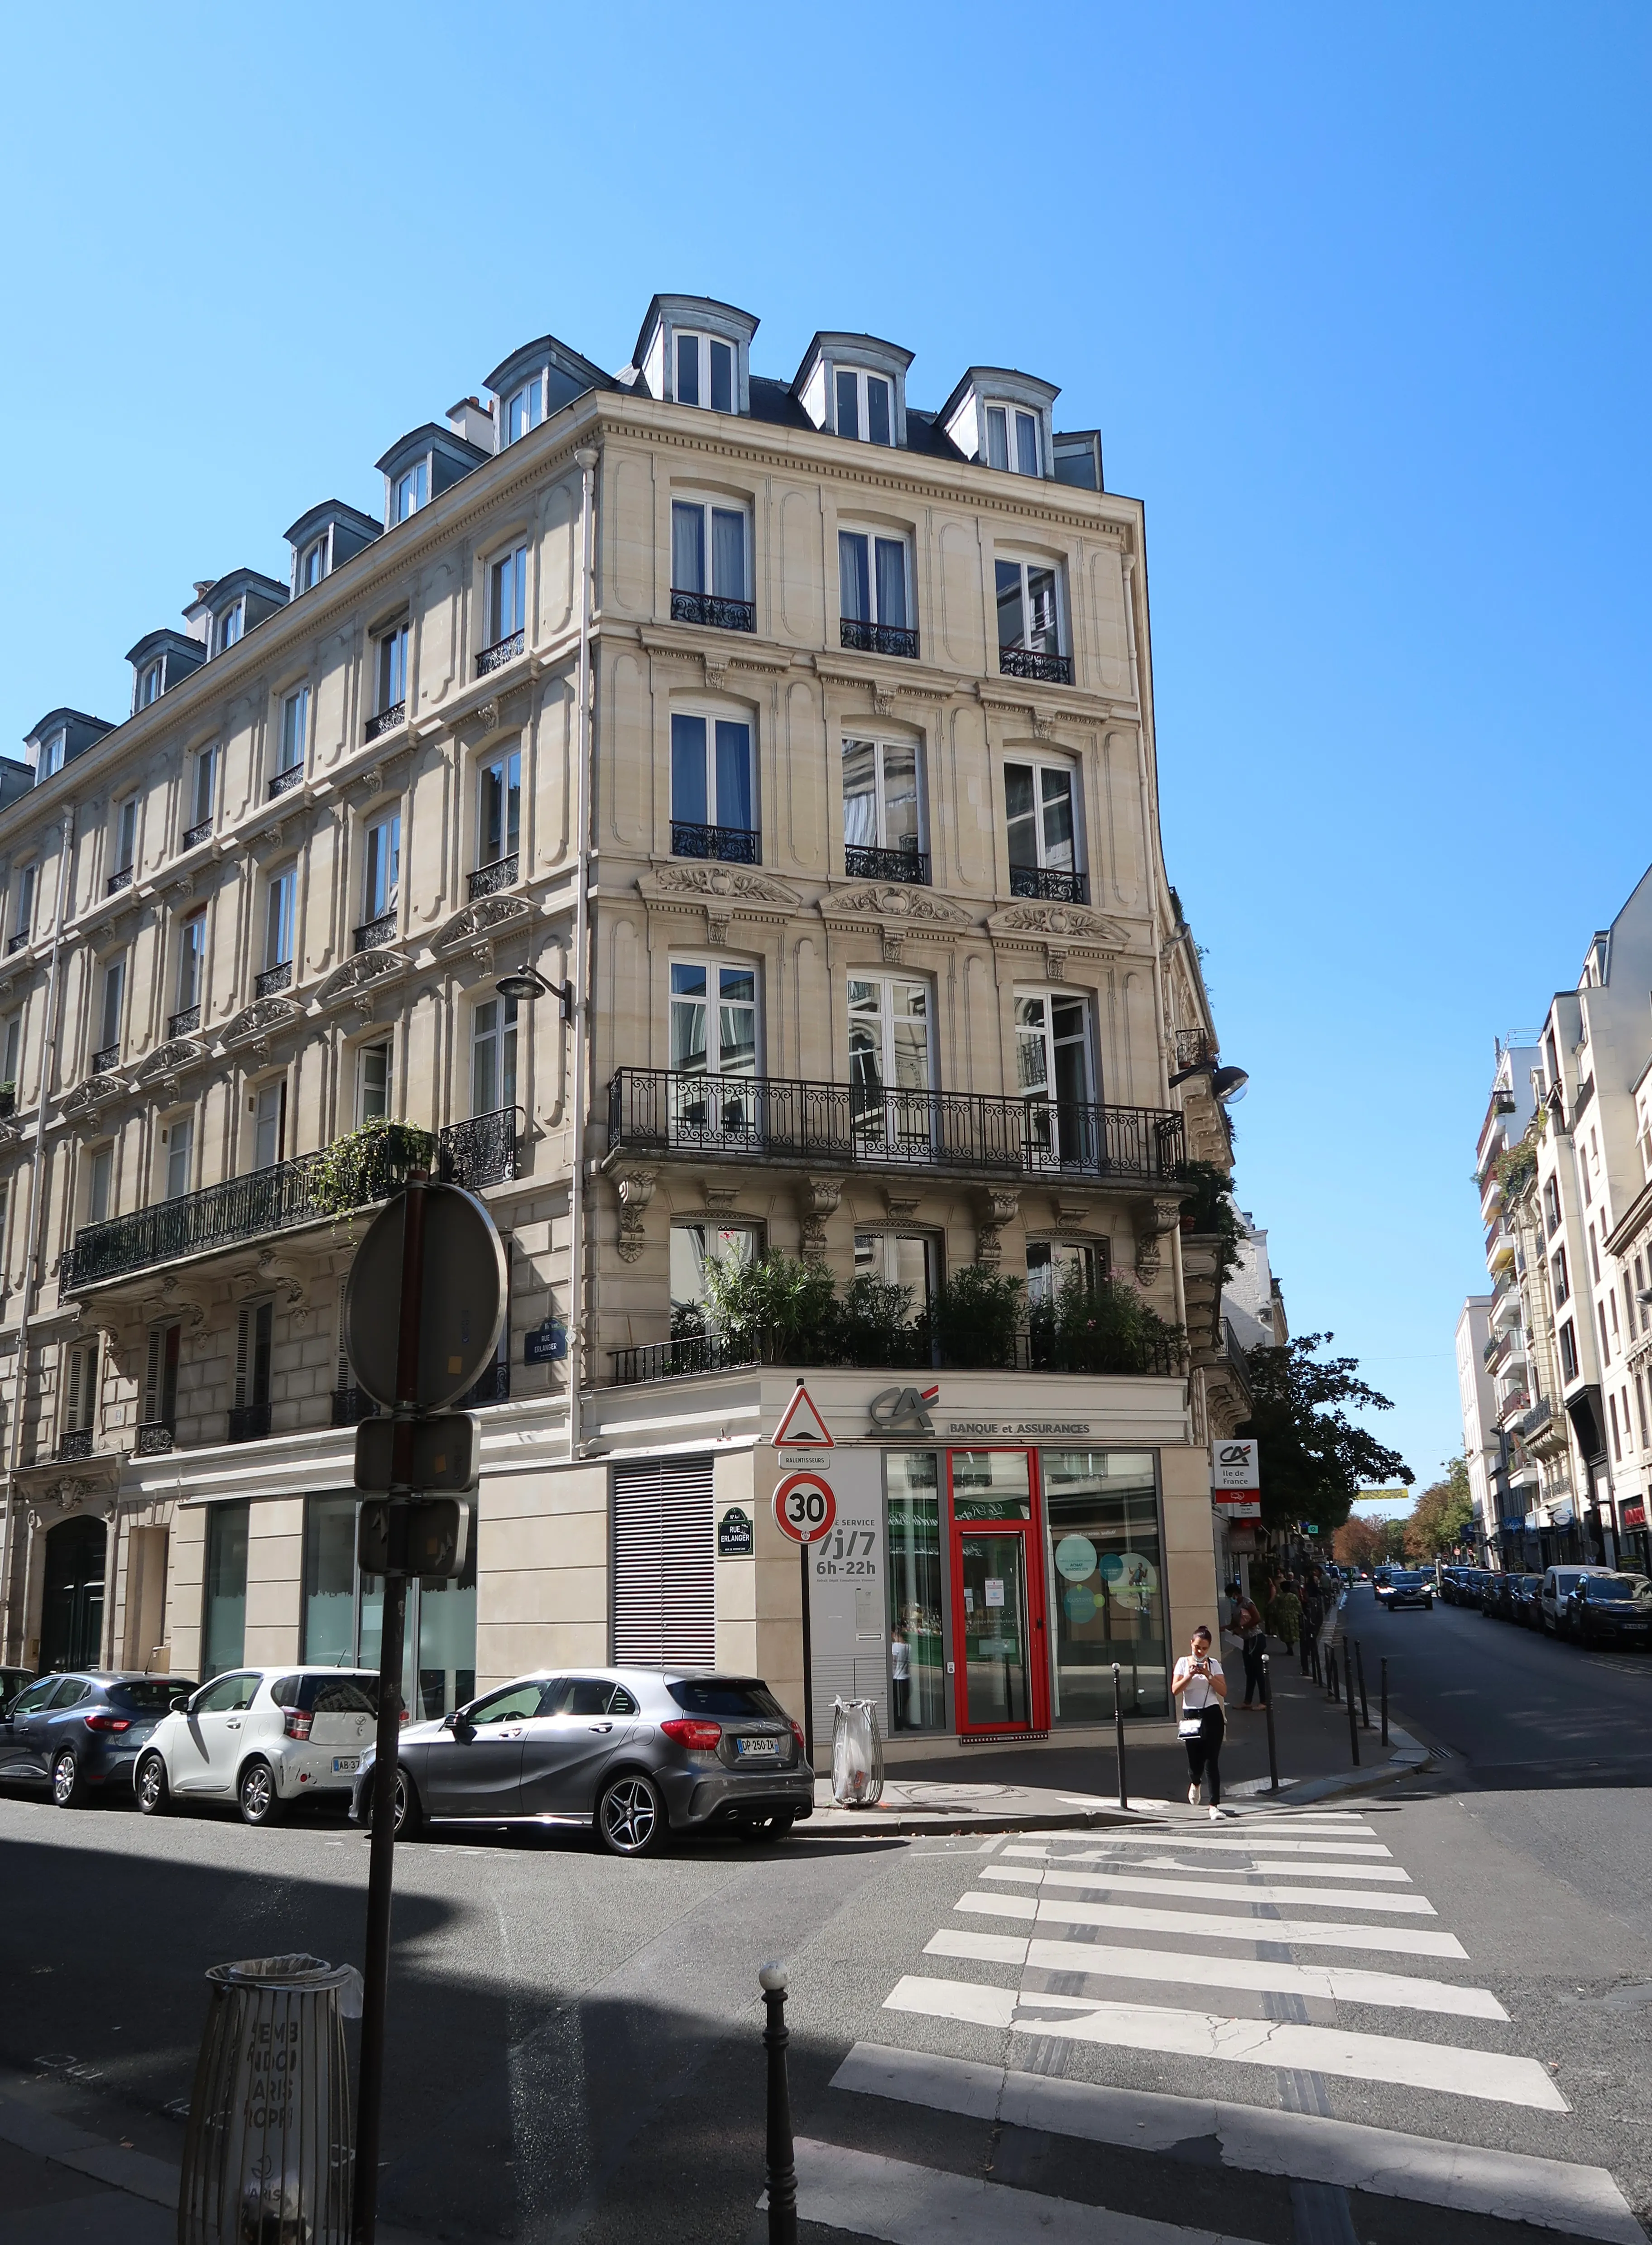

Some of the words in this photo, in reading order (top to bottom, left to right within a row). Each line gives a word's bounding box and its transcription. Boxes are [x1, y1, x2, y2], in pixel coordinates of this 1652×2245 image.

[541, 1334, 550, 1342] RUE
[534, 1343, 557, 1353] ERLANGER
[950, 1423, 998, 1434] BANQUE
[1002, 1425, 1013, 1434] et
[1017, 1424, 1090, 1434] ASSURANCES
[789, 1493, 824, 1522] 30
[721, 1534, 749, 1543] ERLANGER
[816, 1560, 875, 1574] 6h-22h
